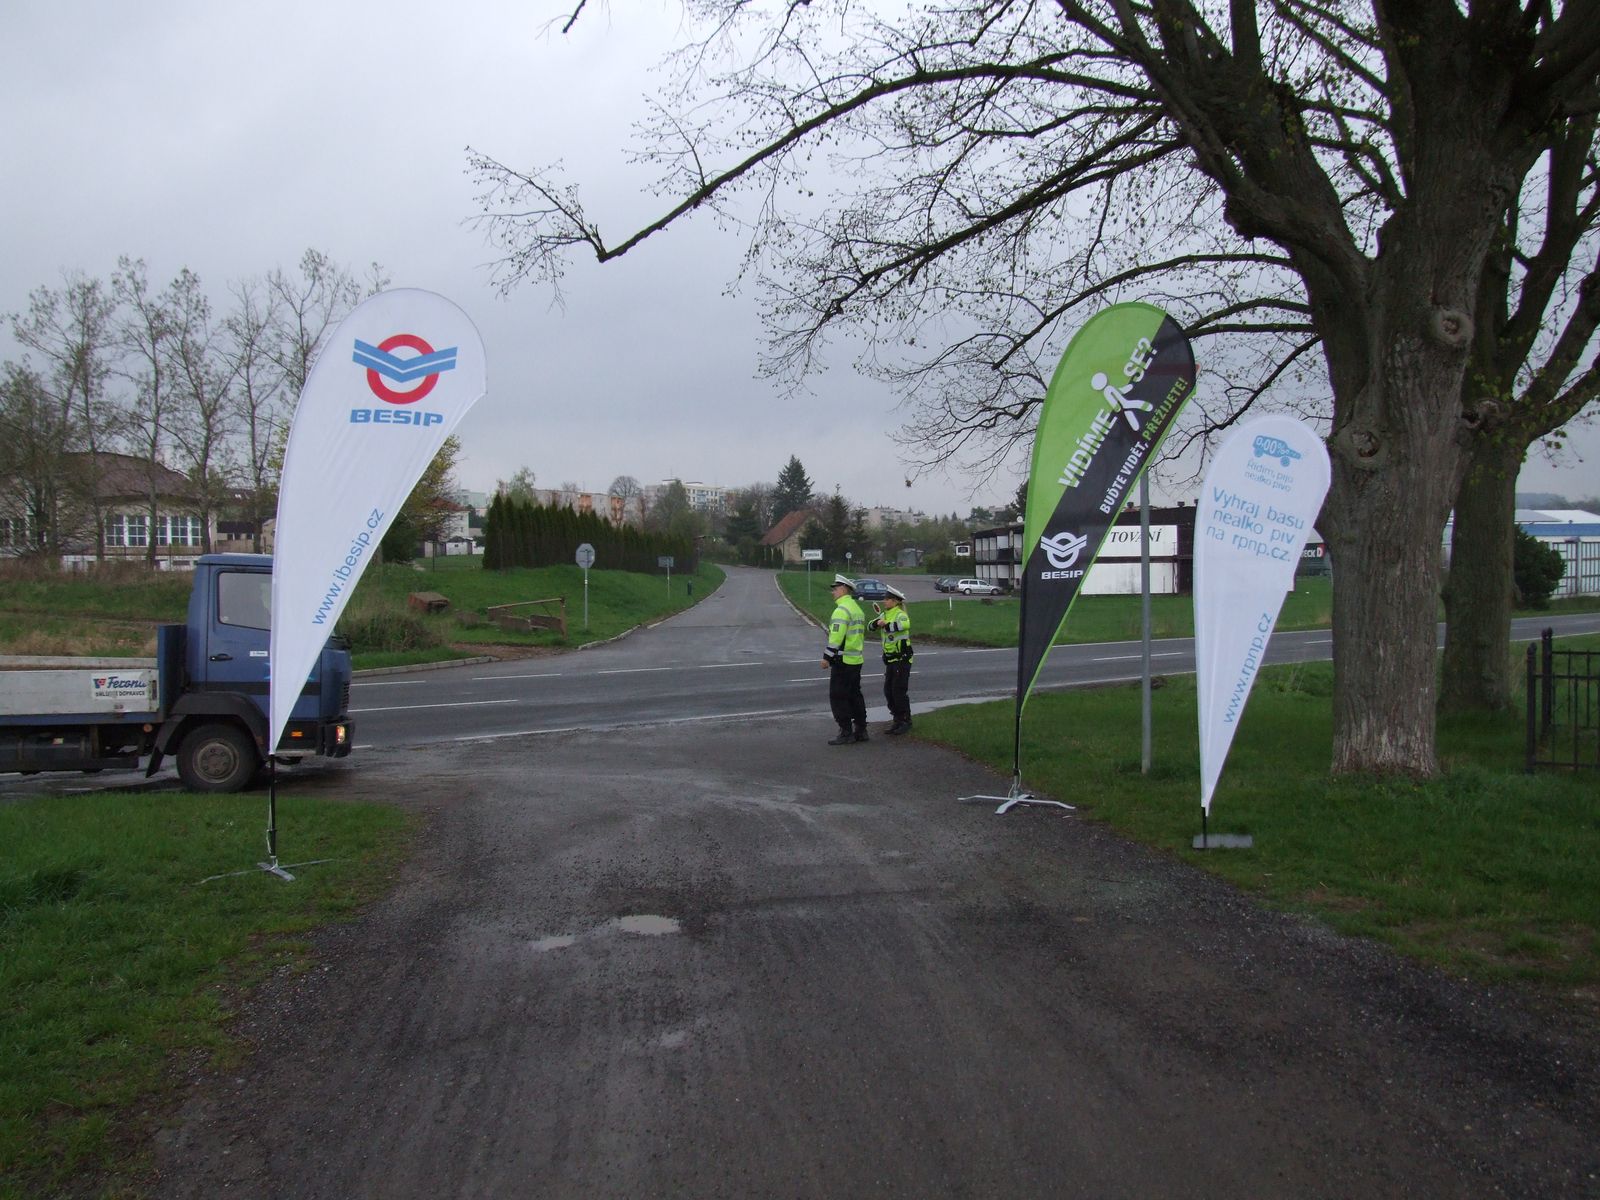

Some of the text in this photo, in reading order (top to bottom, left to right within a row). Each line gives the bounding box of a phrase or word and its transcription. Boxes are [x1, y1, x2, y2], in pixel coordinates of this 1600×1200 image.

[350, 409, 443, 427] BESIP
[1058, 337, 1157, 488] VIDÍME SE?
[1099, 377, 1188, 515] BUĎTE VIDĚT, PŘEŽIJETE!
[1244, 471, 1292, 492] nealko pivo
[1213, 486, 1305, 530] Vyhraj basu
[1213, 509, 1295, 545] nealko piv
[1206, 525, 1291, 562] na rpnp.cz.
[312, 508, 385, 625] www.ibesip.cz
[1041, 569, 1083, 580] BESIP
[1224, 612, 1273, 723] www.rpnp.cz
